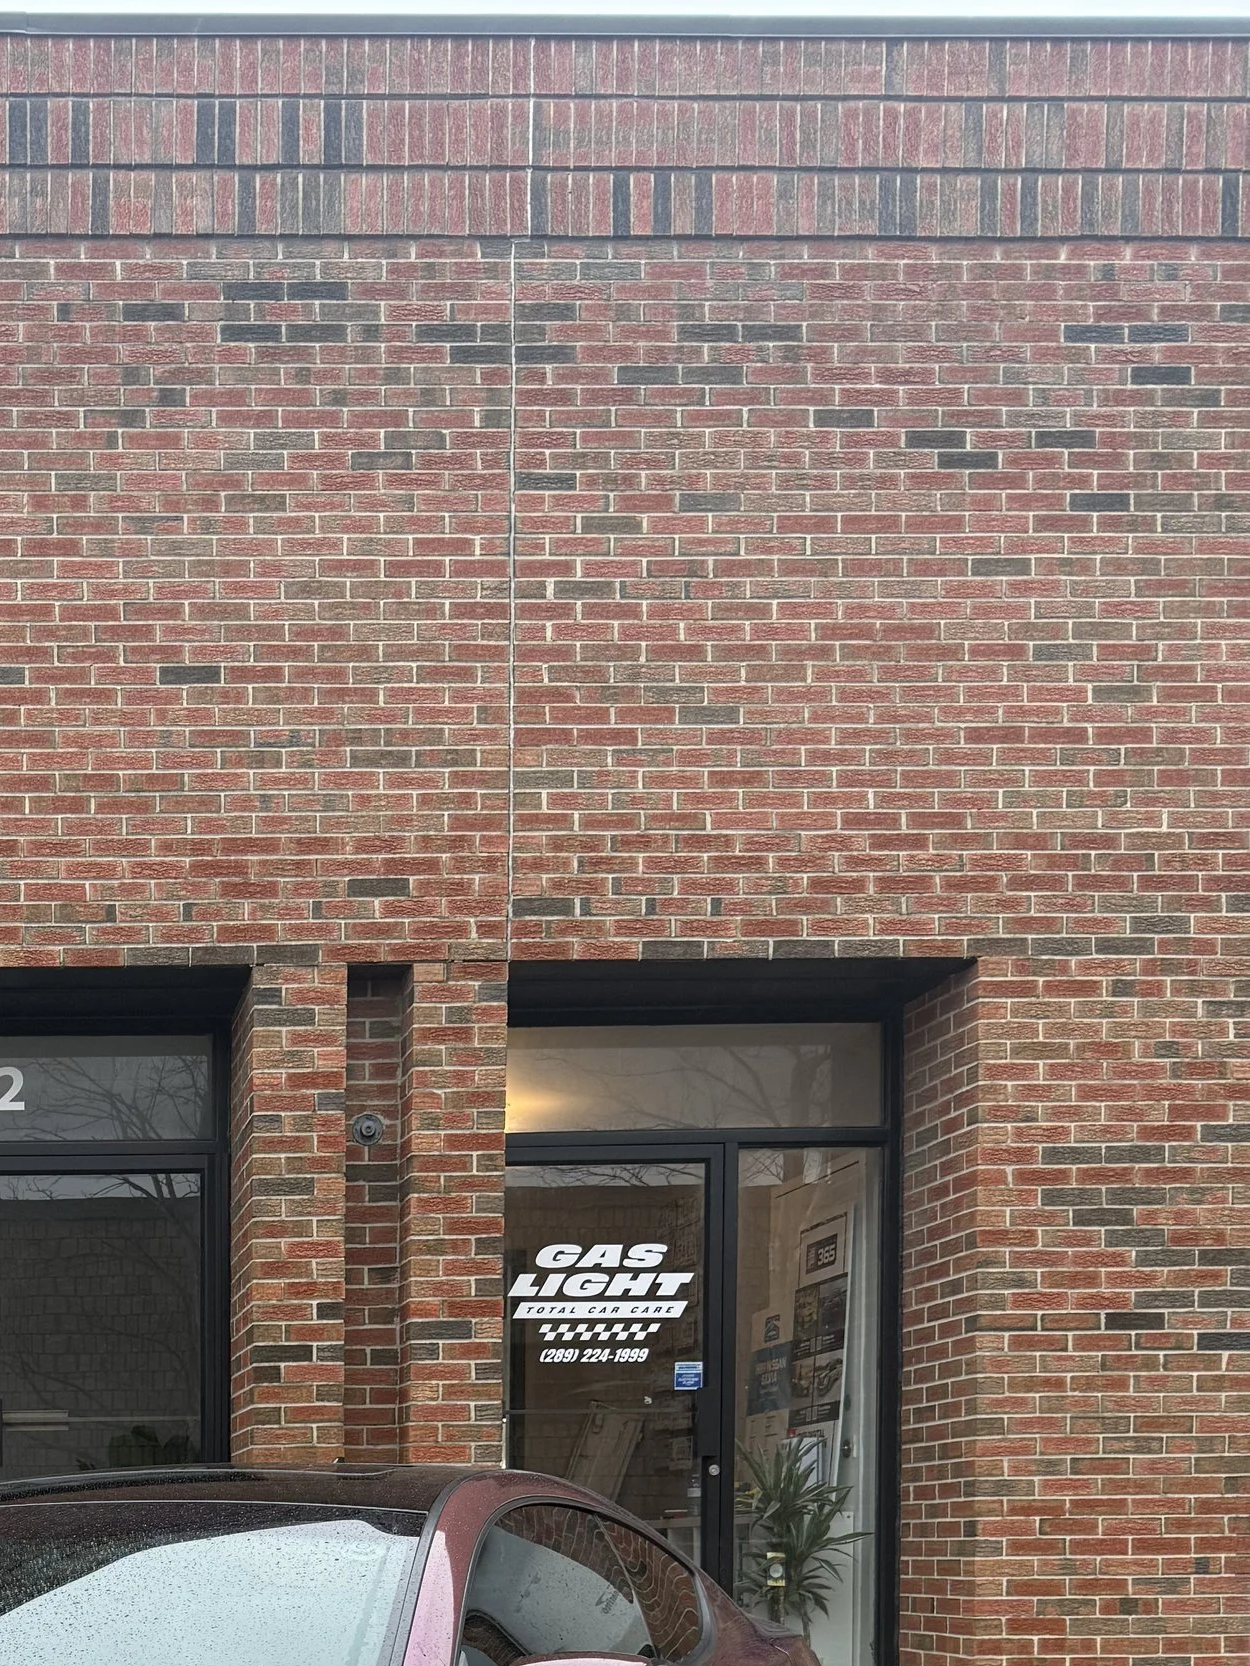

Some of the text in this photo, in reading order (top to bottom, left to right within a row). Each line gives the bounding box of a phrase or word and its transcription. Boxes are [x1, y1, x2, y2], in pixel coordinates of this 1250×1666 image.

[535, 1243, 668, 1268] GAS
[818, 1244, 835, 1265] 365
[507, 1272, 695, 1297] LIGHT
[526, 1306, 674, 1314] TOTAL CAR CARE
[539, 1348, 649, 1363] (289) 224-1999
